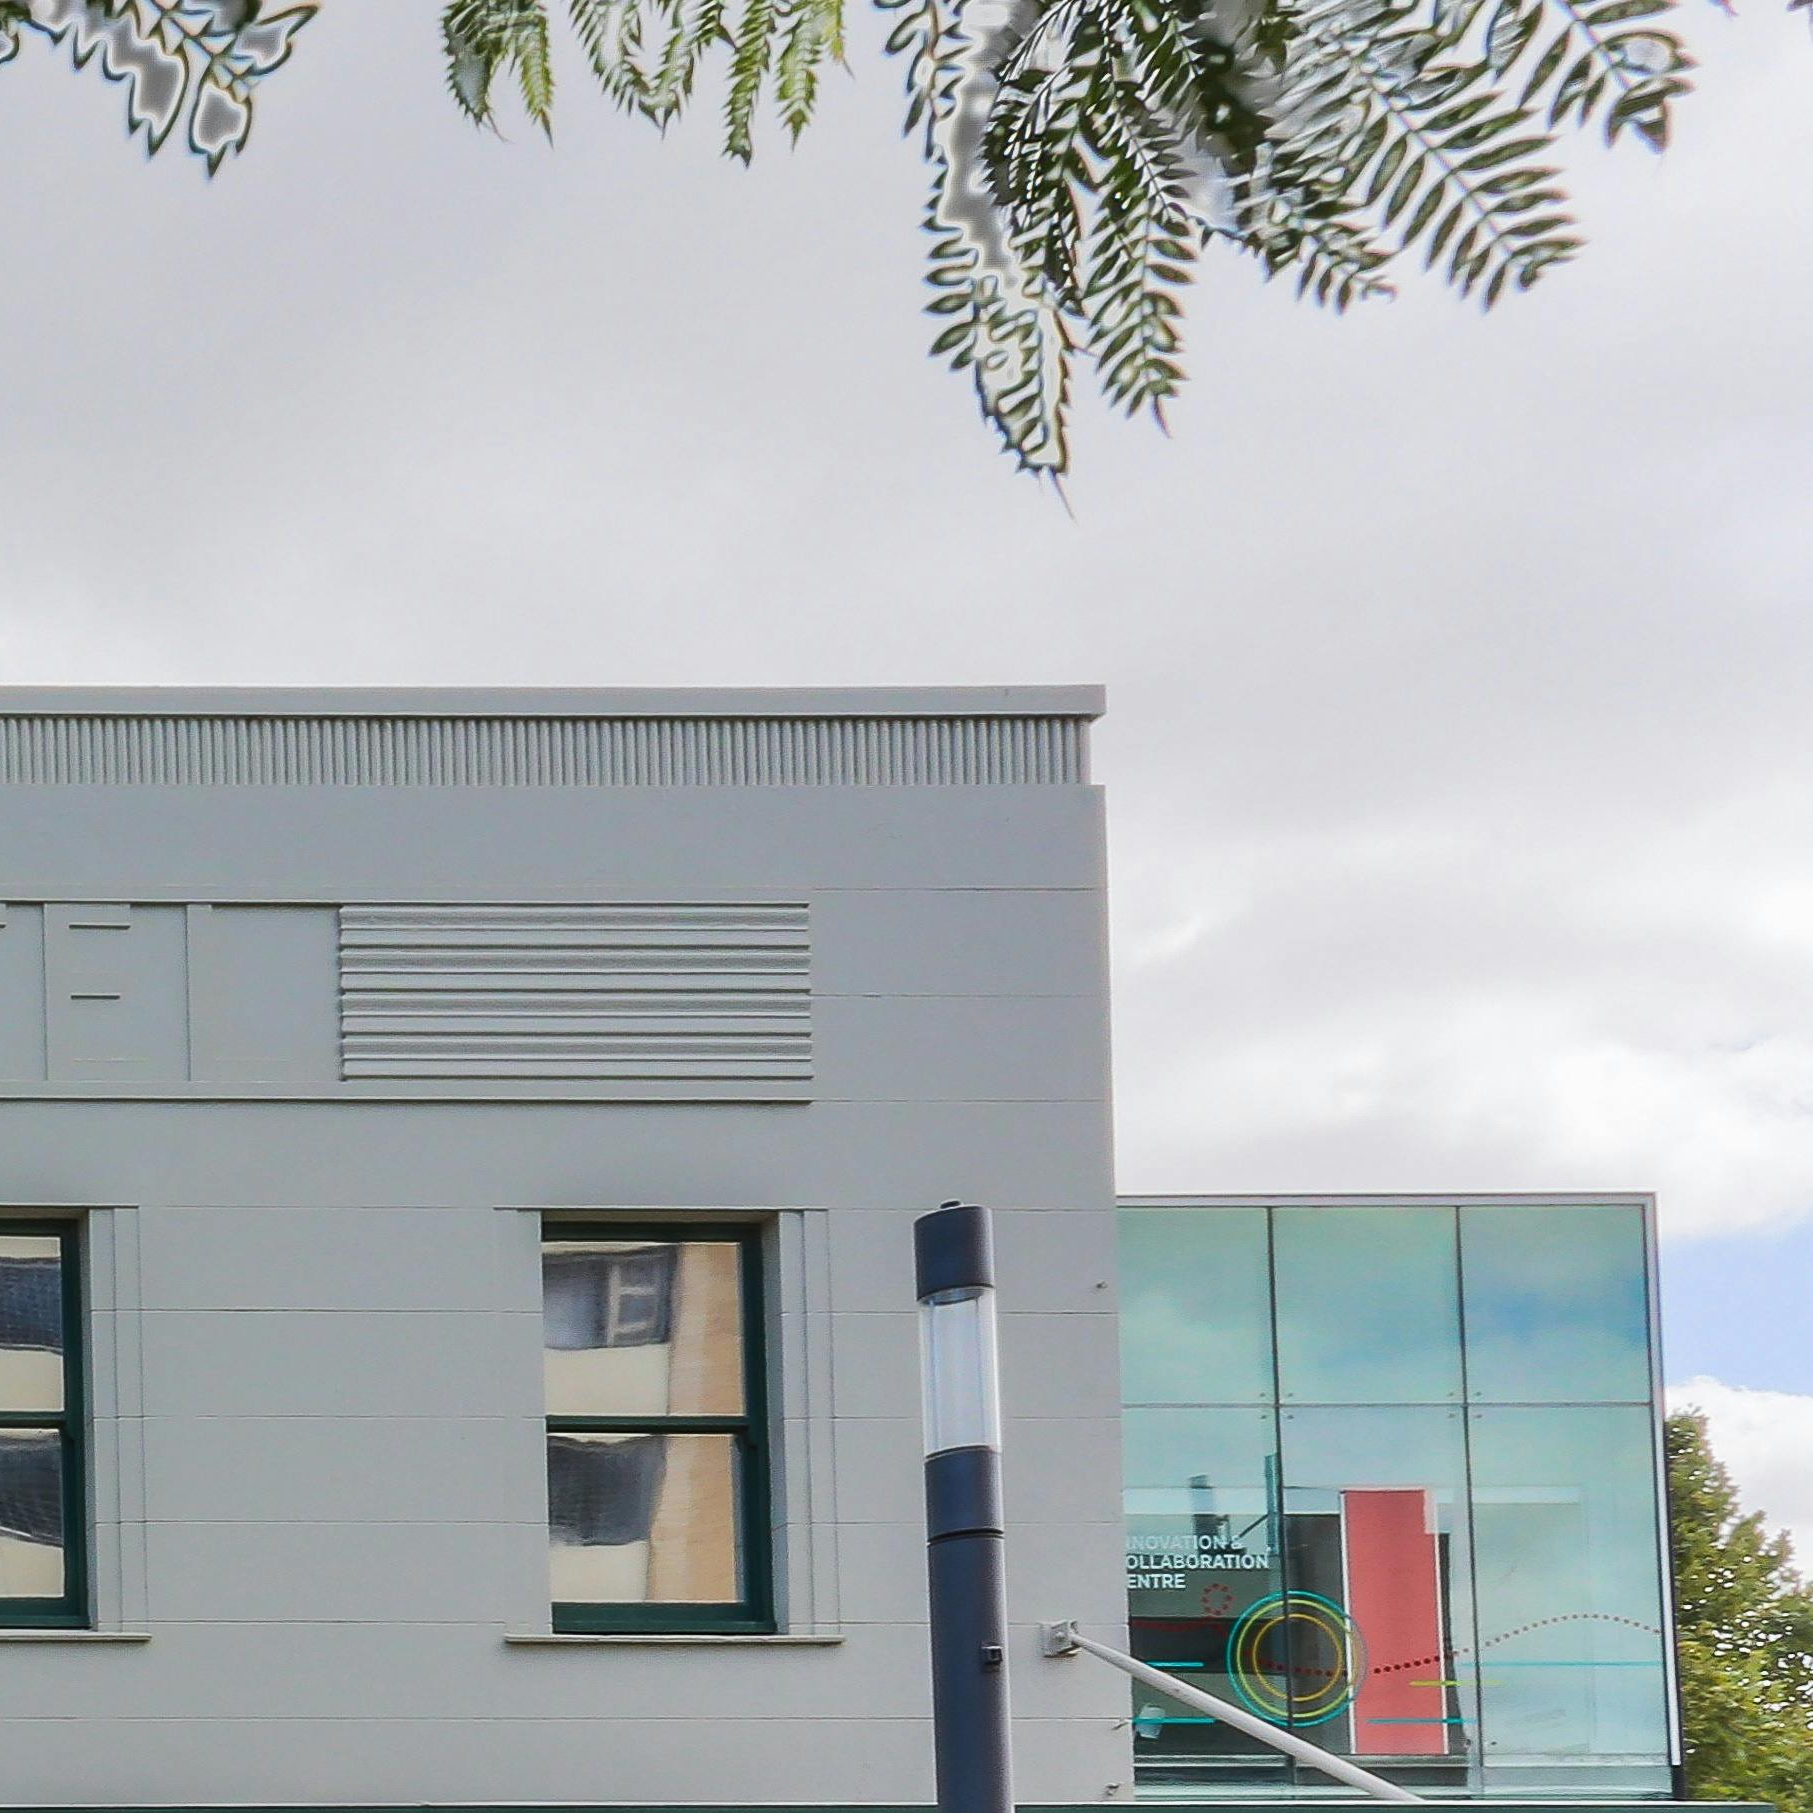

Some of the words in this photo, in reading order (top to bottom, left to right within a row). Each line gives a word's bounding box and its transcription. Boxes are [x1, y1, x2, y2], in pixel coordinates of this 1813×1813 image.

[1127, 1535, 1225, 1550] NOVATION
[1127, 1554, 1269, 1569] OLLABORATION
[1127, 1573, 1186, 1588] ENTRE
